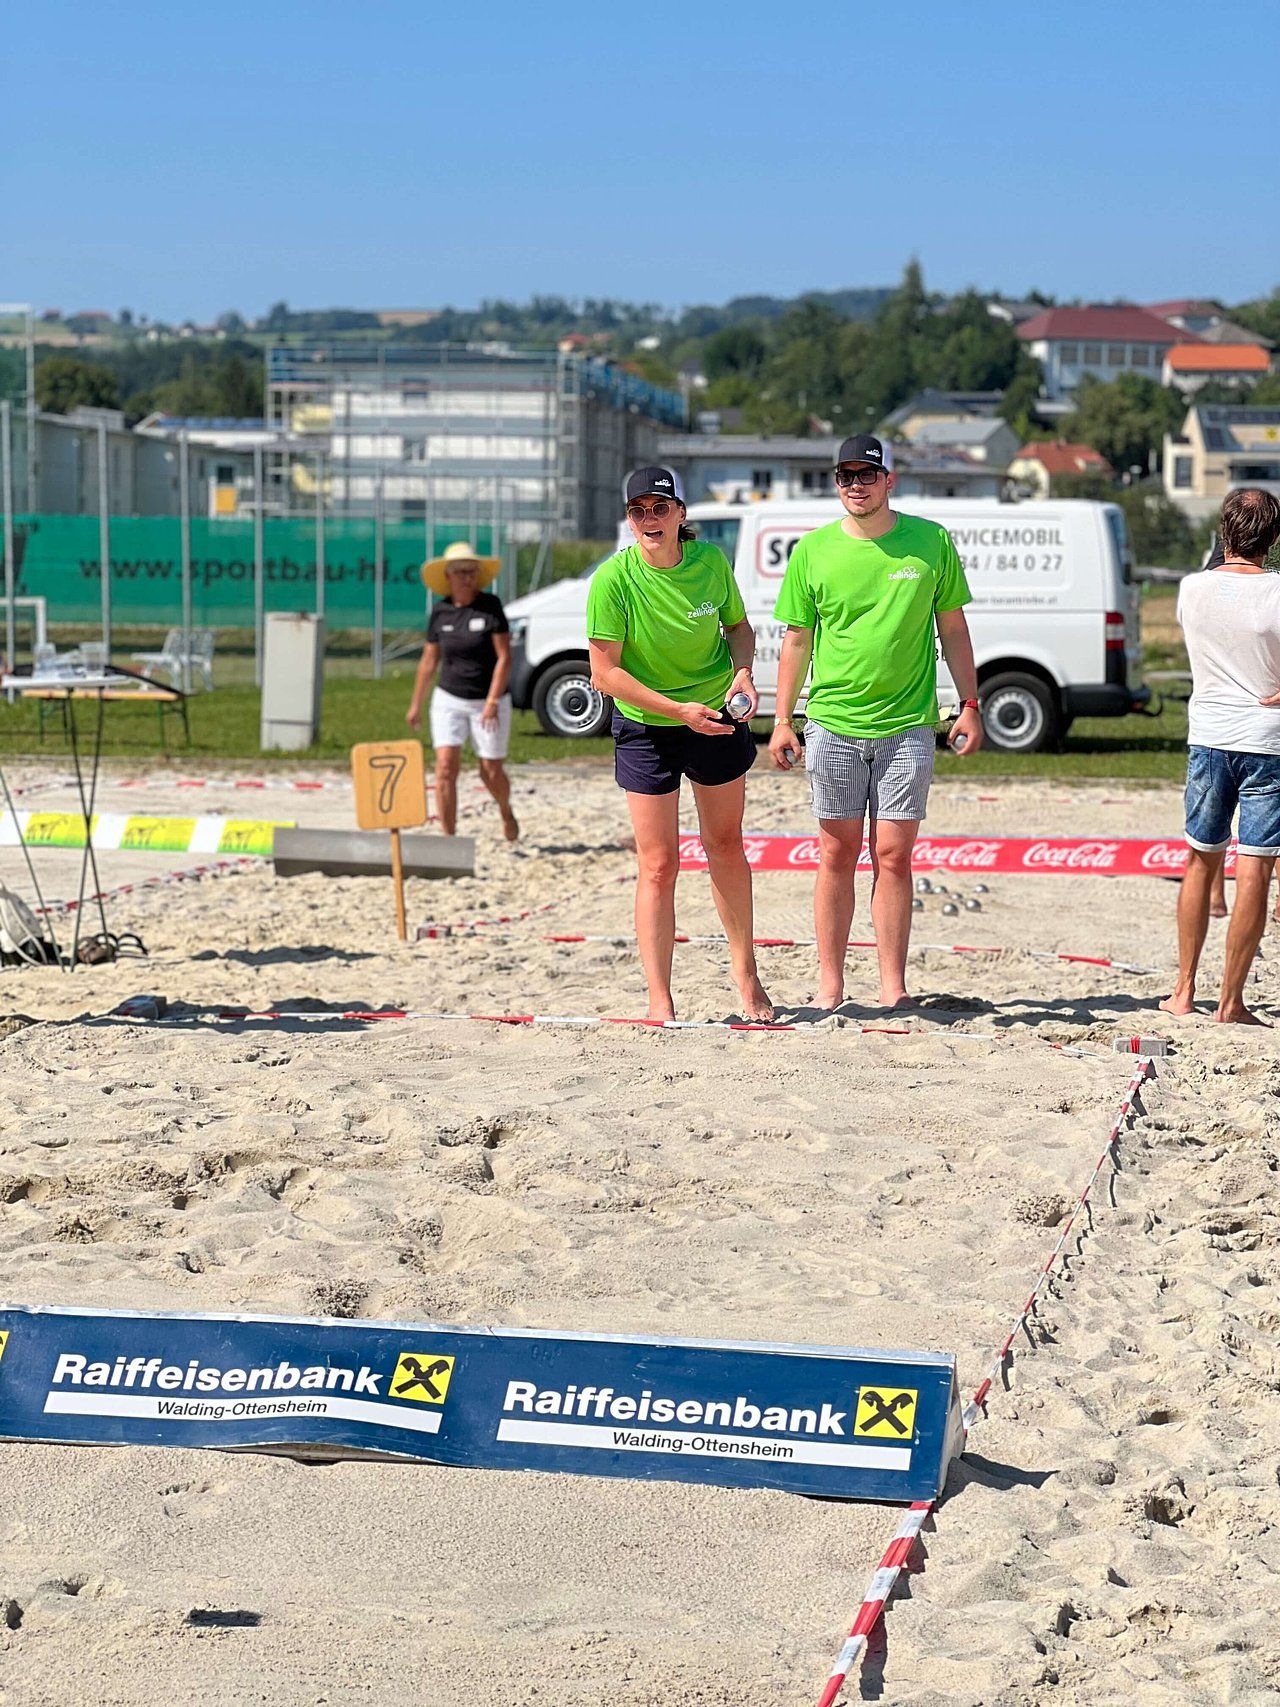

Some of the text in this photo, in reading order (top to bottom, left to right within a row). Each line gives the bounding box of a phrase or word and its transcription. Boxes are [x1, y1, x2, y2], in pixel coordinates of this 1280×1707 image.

[948, 528, 1064, 547] RVICEMOBIL
[996, 554, 1018, 571] 84
[1024, 554, 1036, 571] 0
[1042, 554, 1063, 571] 27
[369, 755, 407, 814] 7
[52, 1353, 384, 1396] Raiffeisenbank
[157, 1400, 328, 1419] Walding-Ottensheim
[502, 1380, 847, 1436] Raiffeisenbank
[612, 1431, 795, 1459] Walding-Ottensheim
